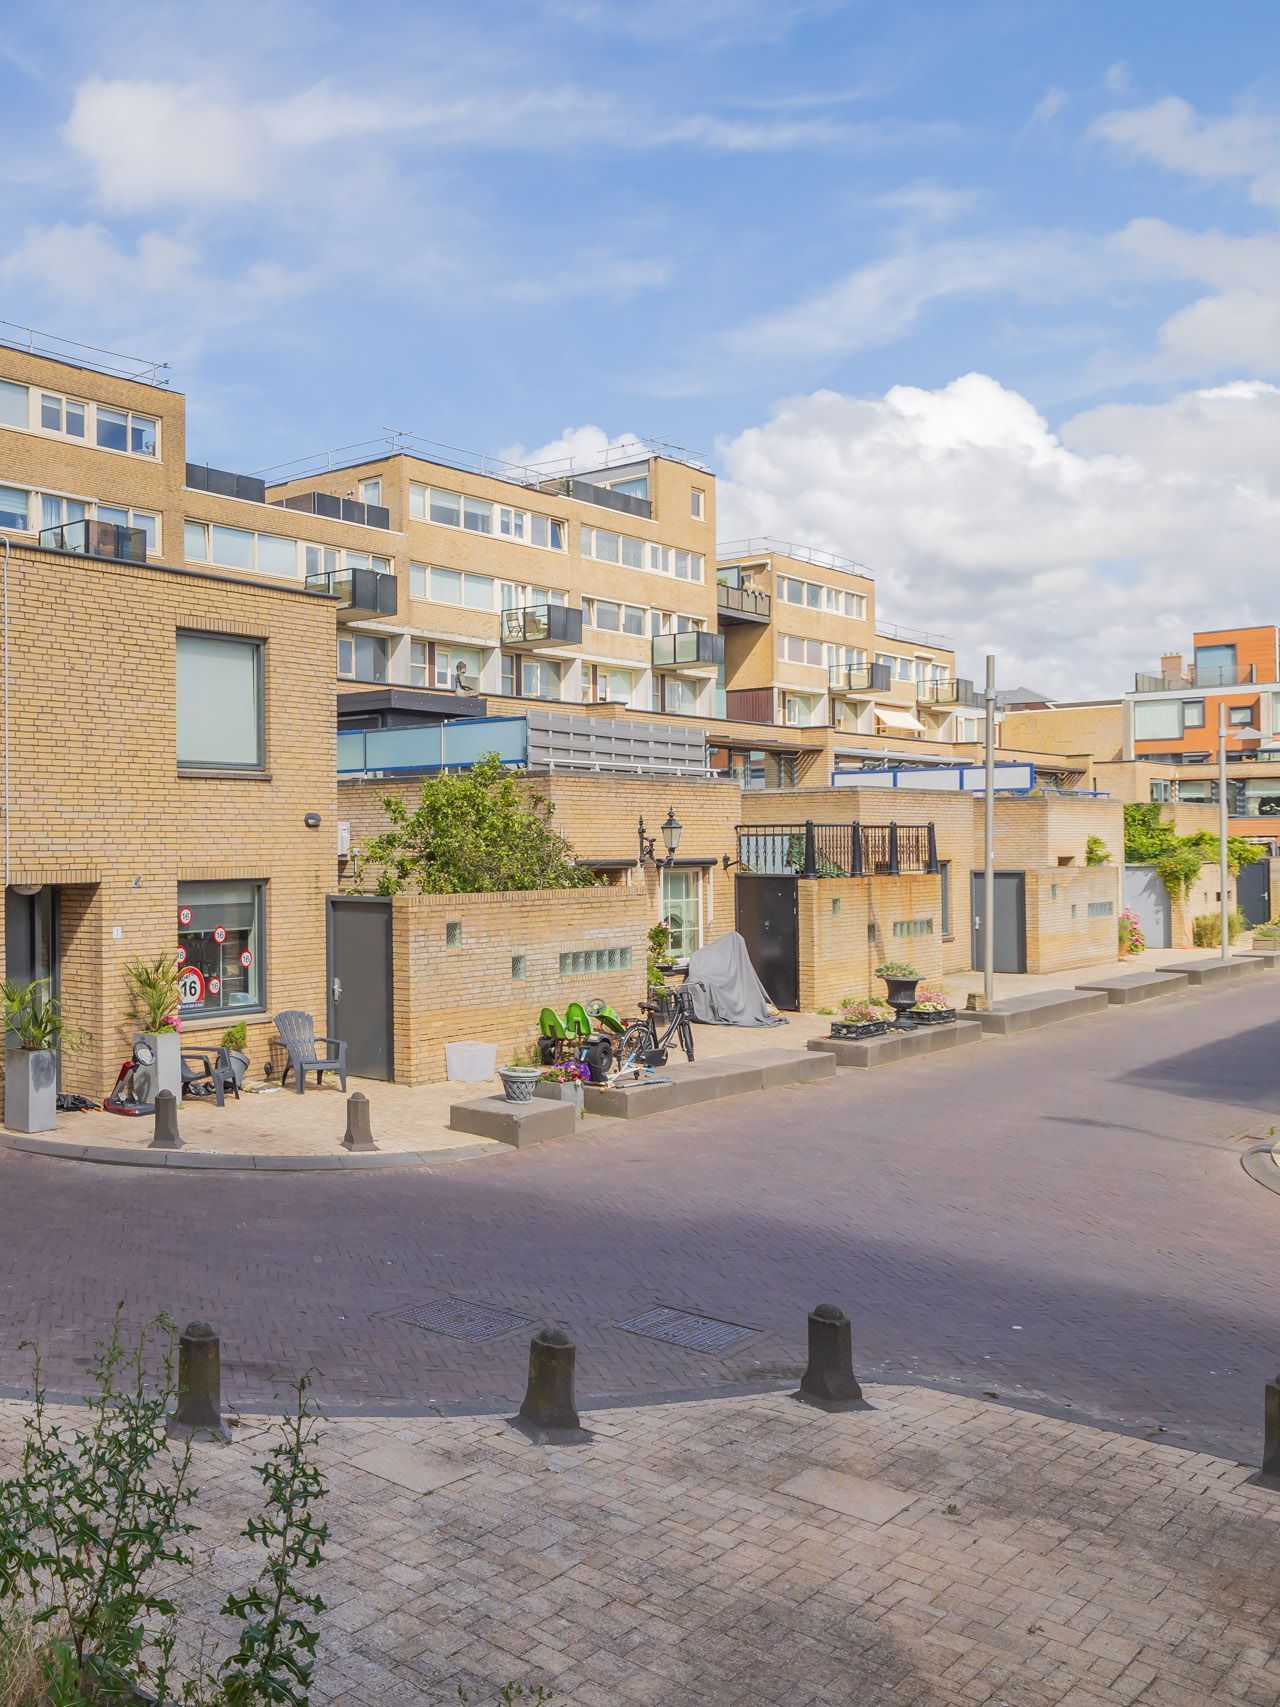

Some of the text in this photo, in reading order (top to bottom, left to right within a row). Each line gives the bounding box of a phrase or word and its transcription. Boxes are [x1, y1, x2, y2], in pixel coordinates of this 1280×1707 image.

[182, 912, 190, 921] 16
[216, 932, 224, 940] 16
[242, 954, 250, 964] 16
[182, 980, 197, 997] 16
